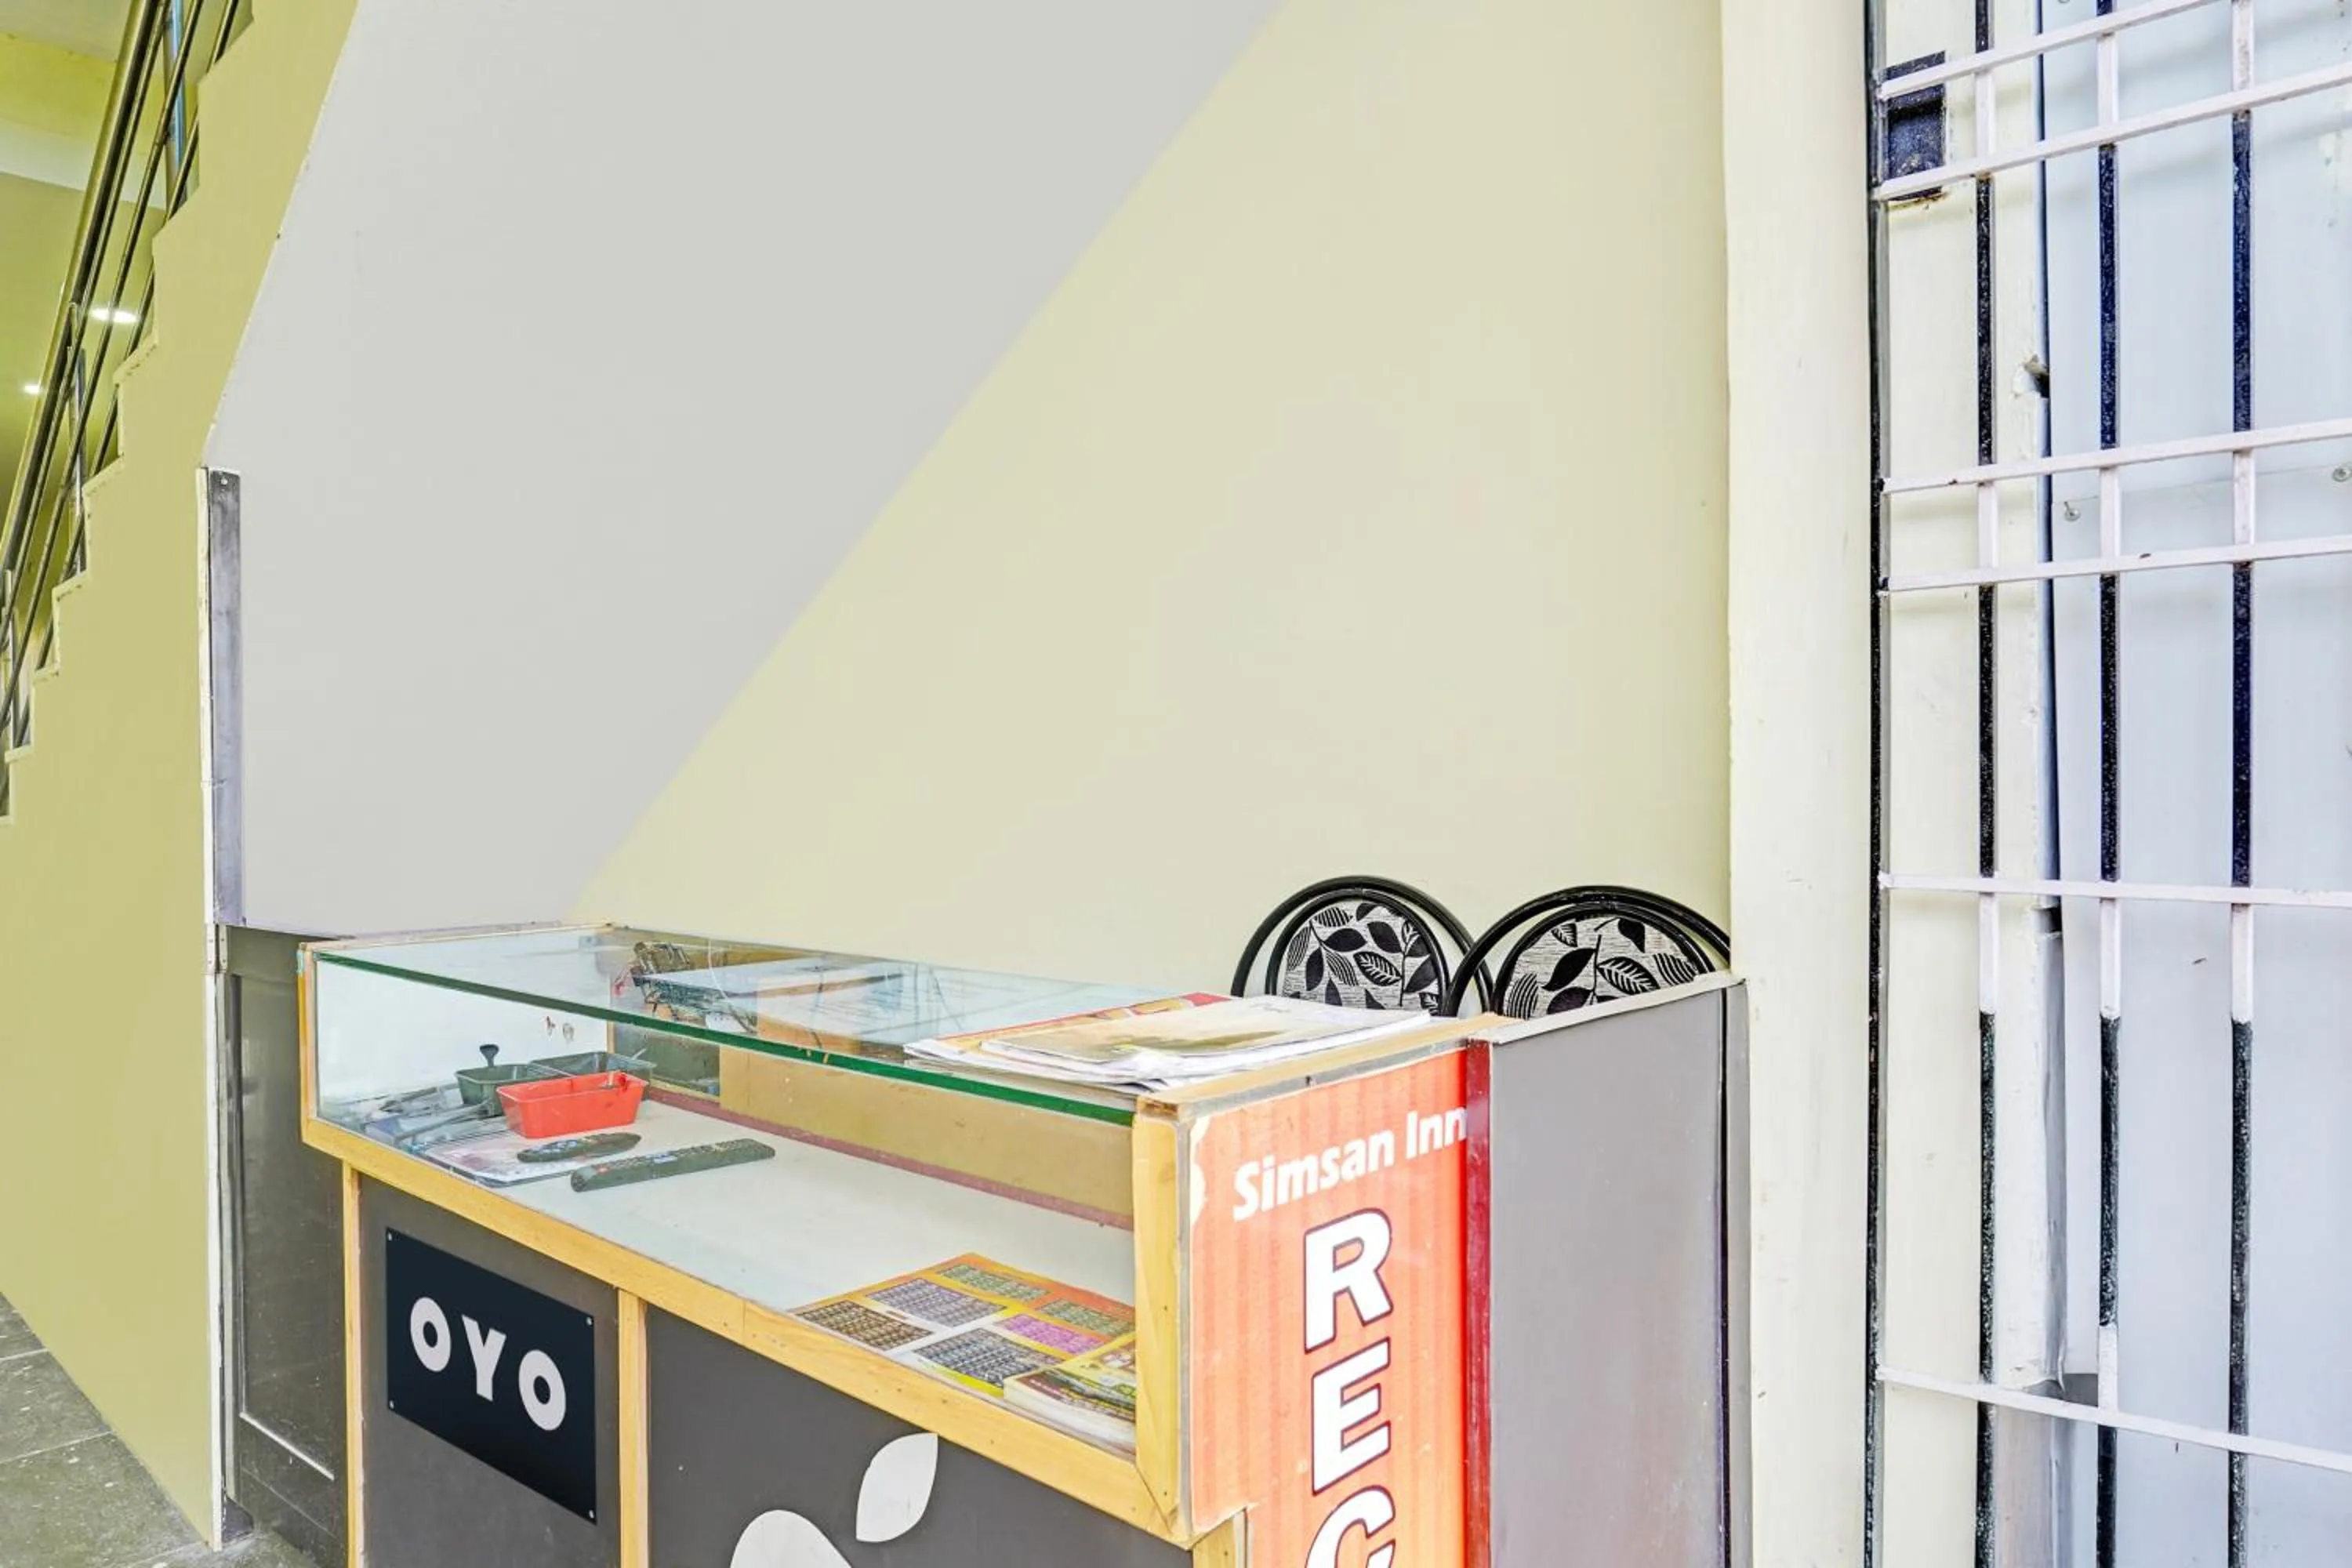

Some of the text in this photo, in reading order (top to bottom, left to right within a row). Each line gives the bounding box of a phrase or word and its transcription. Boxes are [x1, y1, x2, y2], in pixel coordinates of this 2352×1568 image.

[1232, 1106, 1468, 1221] Simsan Inn
[410, 1297, 567, 1431] OYO
